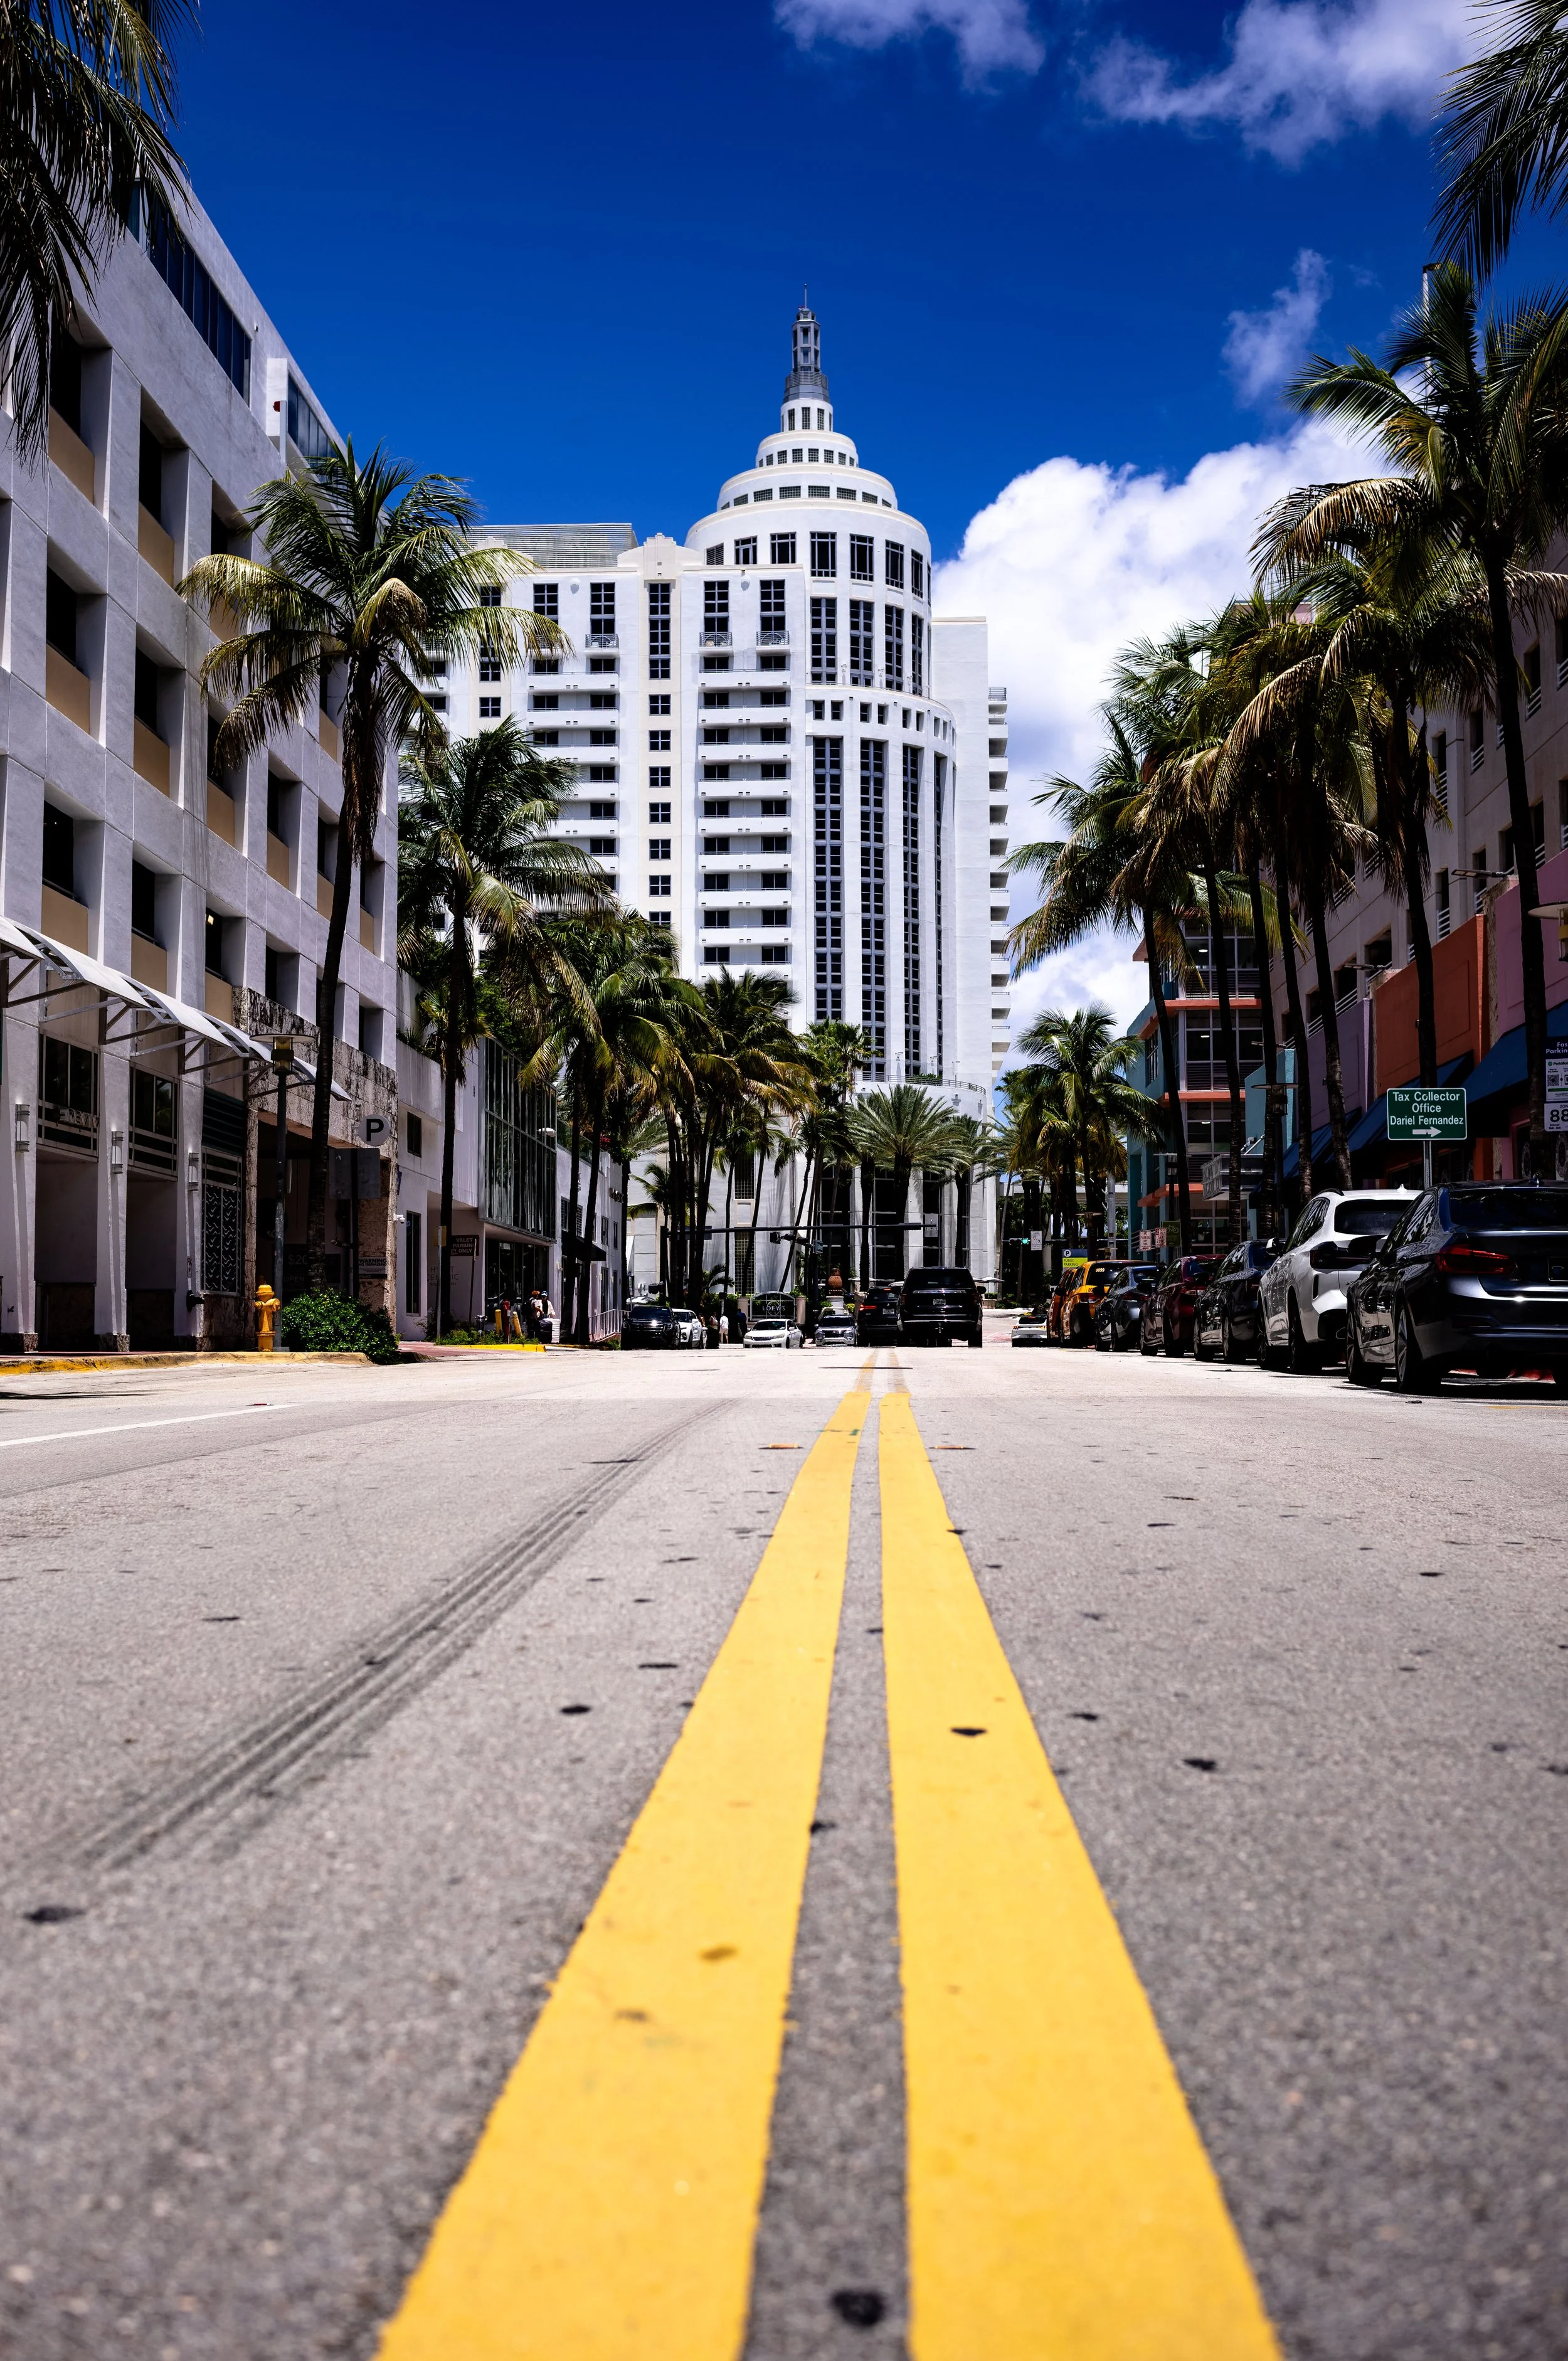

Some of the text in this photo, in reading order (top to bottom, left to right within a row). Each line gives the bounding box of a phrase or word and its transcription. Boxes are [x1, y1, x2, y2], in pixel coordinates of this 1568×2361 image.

[1392, 1091, 1460, 1101] Tax Collector
[1412, 1103, 1441, 1113] Office
[1390, 1115, 1464, 1125] Dariel Fernandez
[366, 1118, 384, 1142] P
